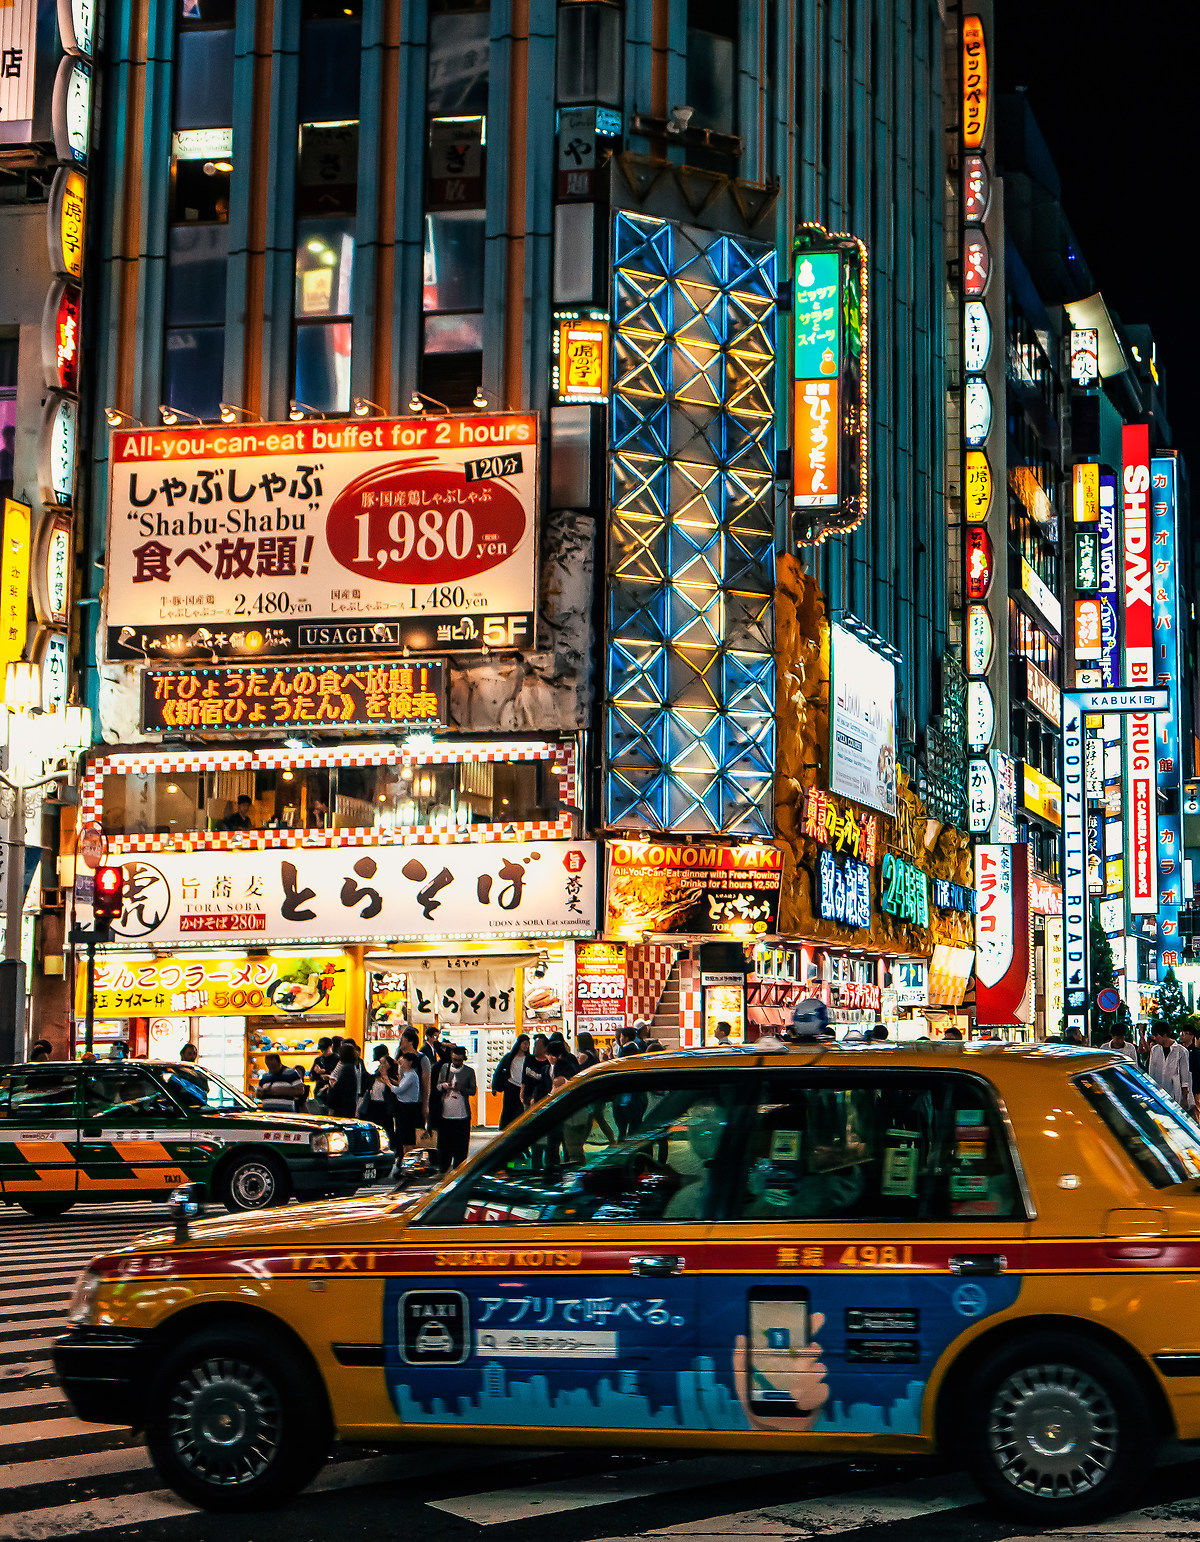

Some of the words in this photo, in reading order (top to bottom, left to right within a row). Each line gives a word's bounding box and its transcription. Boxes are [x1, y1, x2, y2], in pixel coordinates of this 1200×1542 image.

[1, 48, 22, 78] 店
[563, 138, 592, 165] や
[798, 329, 836, 346] スイーツ
[573, 345, 593, 379] 虎の子
[123, 426, 304, 459] All-you-can-eat
[312, 422, 384, 448] buffet
[391, 424, 426, 446] for
[435, 424, 452, 444] 2
[459, 422, 529, 443] hours
[470, 457, 518, 481] 120分
[129, 465, 325, 507] しゃぶしゃぶ
[809, 495, 825, 506] 7F
[352, 508, 473, 569] 1,980
[476, 542, 507, 558] yen
[1123, 464, 1151, 608] SHIDAX
[234, 590, 290, 617] 2,480
[290, 601, 312, 617] yen
[410, 585, 465, 611] 1,480
[466, 595, 488, 610] yen
[482, 616, 528, 646] 5F
[365, 692, 438, 719] を検索
[1066, 737, 1081, 878] GODZILLA
[614, 845, 723, 868] OKONOMI
[731, 848, 781, 868] YAKI
[280, 852, 541, 922] とらそば
[614, 868, 680, 879] All-You-Can-Eat
[680, 868, 709, 879] dinner
[709, 869, 728, 880] with
[727, 870, 781, 882] Free-Flowing
[679, 878, 708, 890] Drinks
[707, 879, 721, 890] for
[727, 879, 754, 890] hours
[980, 853, 997, 932] トラノコ
[1159, 829, 1178, 967] カラオケ館
[185, 902, 223, 914] TORA
[226, 901, 262, 913] SOBA
[522, 918, 545, 927] SOBA
[1067, 895, 1083, 963] ROAD
[416, 987, 515, 1014] とらそば
[163, 1173, 182, 1184] TAXI
[291, 1252, 377, 1271] TAXI
[513, 1250, 582, 1266] KOTSU
[838, 1246, 913, 1266] 4981
[410, 1304, 457, 1318] TAXI
